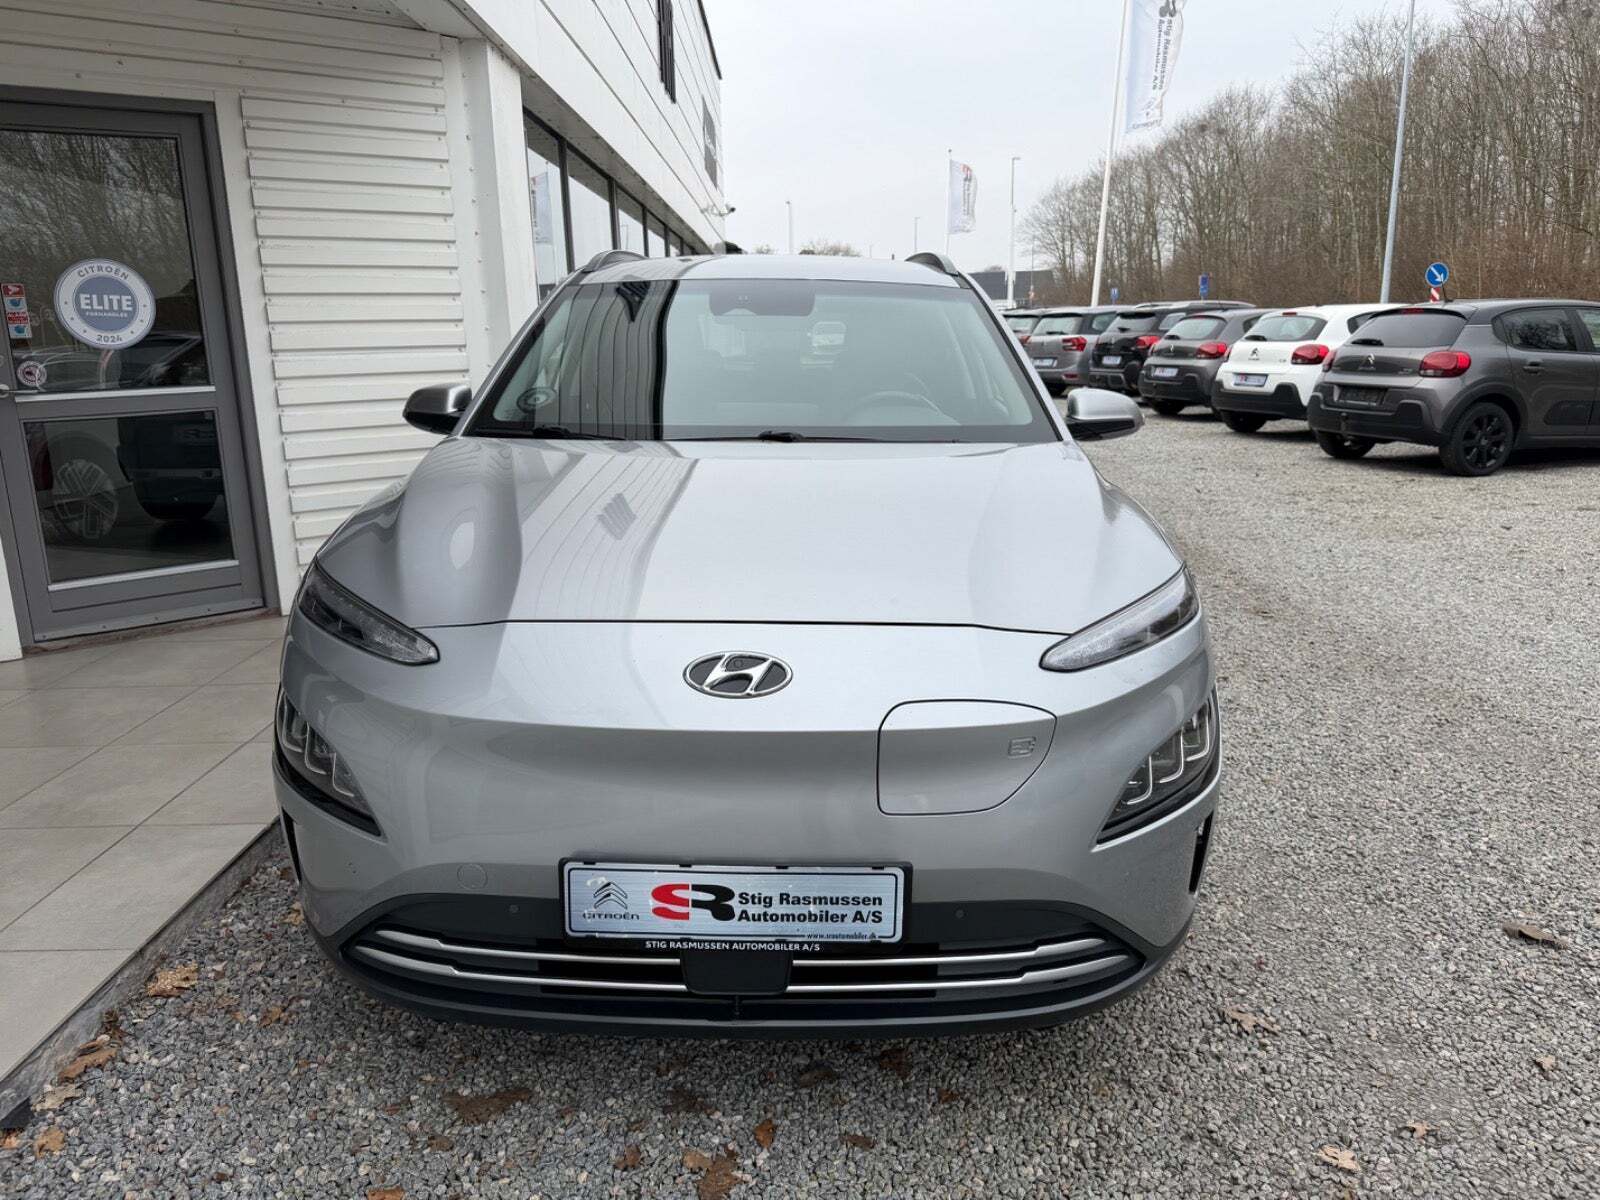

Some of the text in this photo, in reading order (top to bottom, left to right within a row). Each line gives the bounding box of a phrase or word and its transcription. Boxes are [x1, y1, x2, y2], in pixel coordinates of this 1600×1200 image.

[80, 293, 133, 311] ELITE
[96, 334, 122, 343] 2024
[738, 892, 883, 908] Stig Rasmussen
[738, 909, 883, 924] Automobiler A/S
[645, 940, 821, 952] STIG RASMUSSEN AUTOMOBILER A/S
